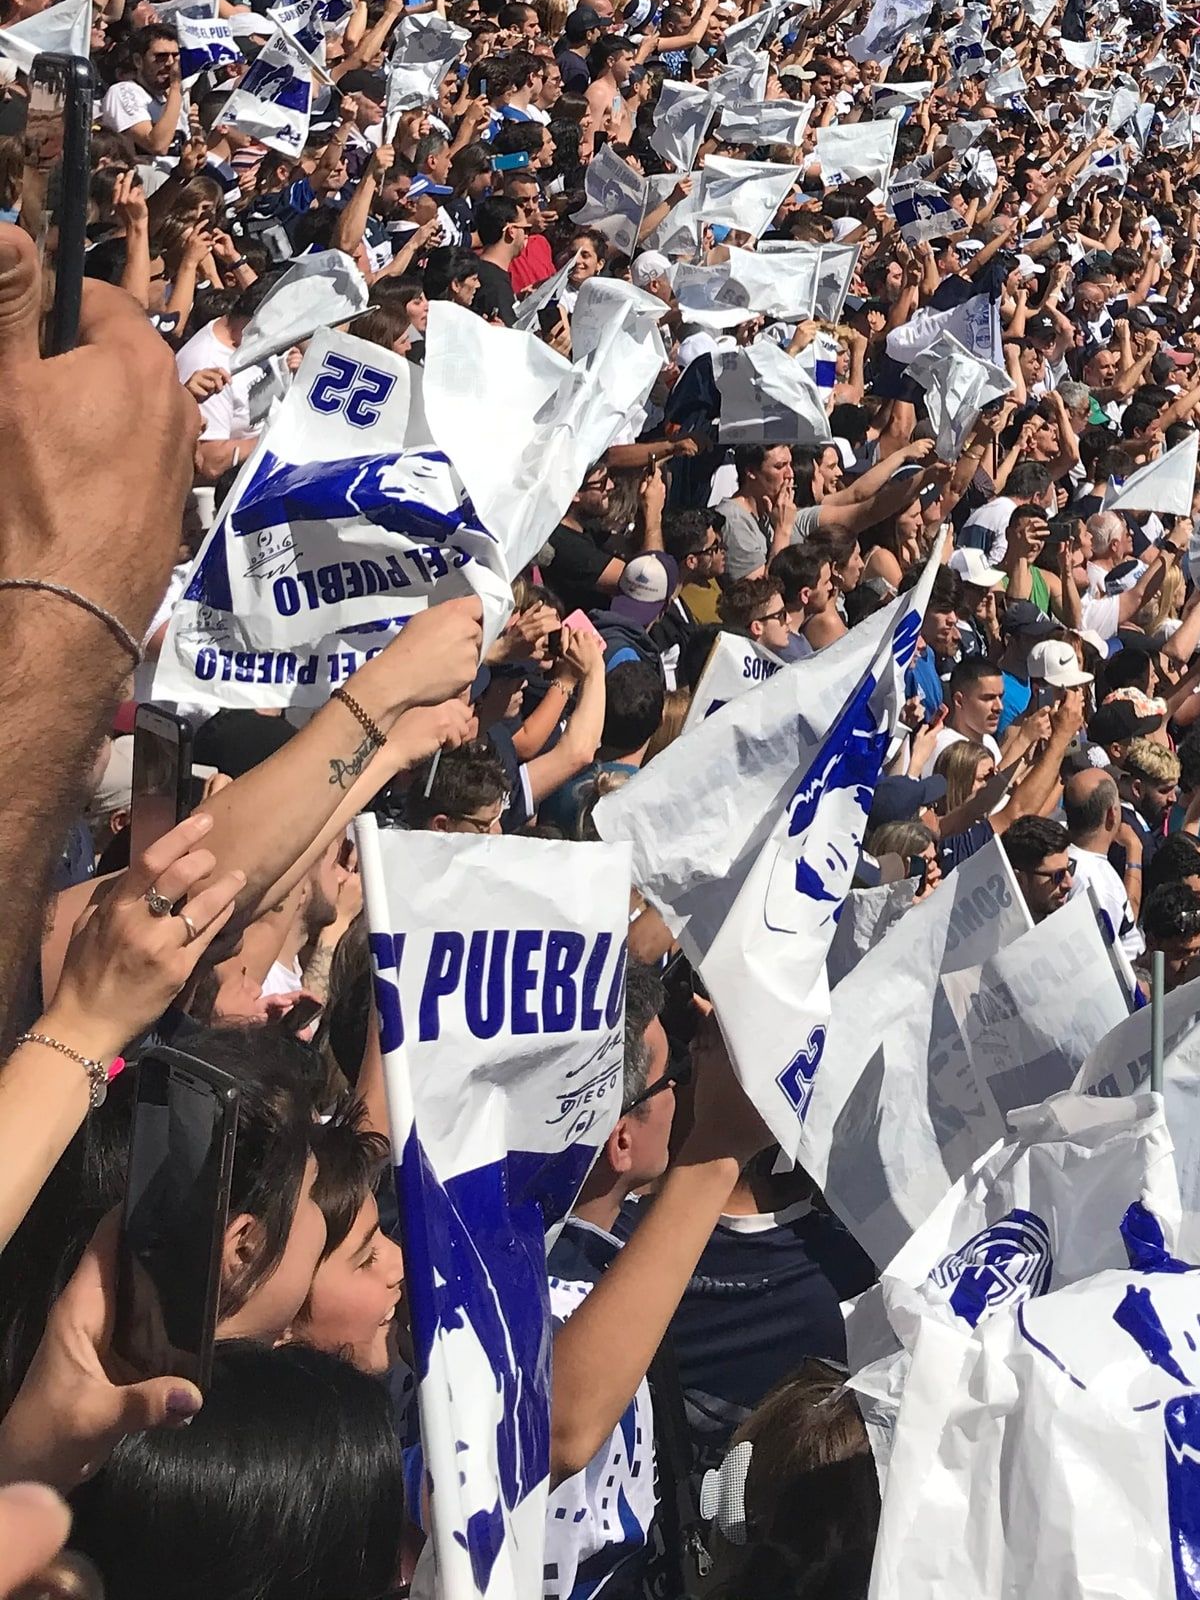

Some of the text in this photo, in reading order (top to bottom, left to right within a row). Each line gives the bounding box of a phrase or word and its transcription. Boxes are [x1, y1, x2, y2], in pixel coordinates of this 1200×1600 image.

[950, 217, 968, 231] 22
[306, 350, 398, 430] 22
[273, 552, 412, 617] PUEBLO
[404, 545, 448, 588] EL
[194, 646, 319, 686] PUEBLO
[775, 1024, 827, 1127] 2
